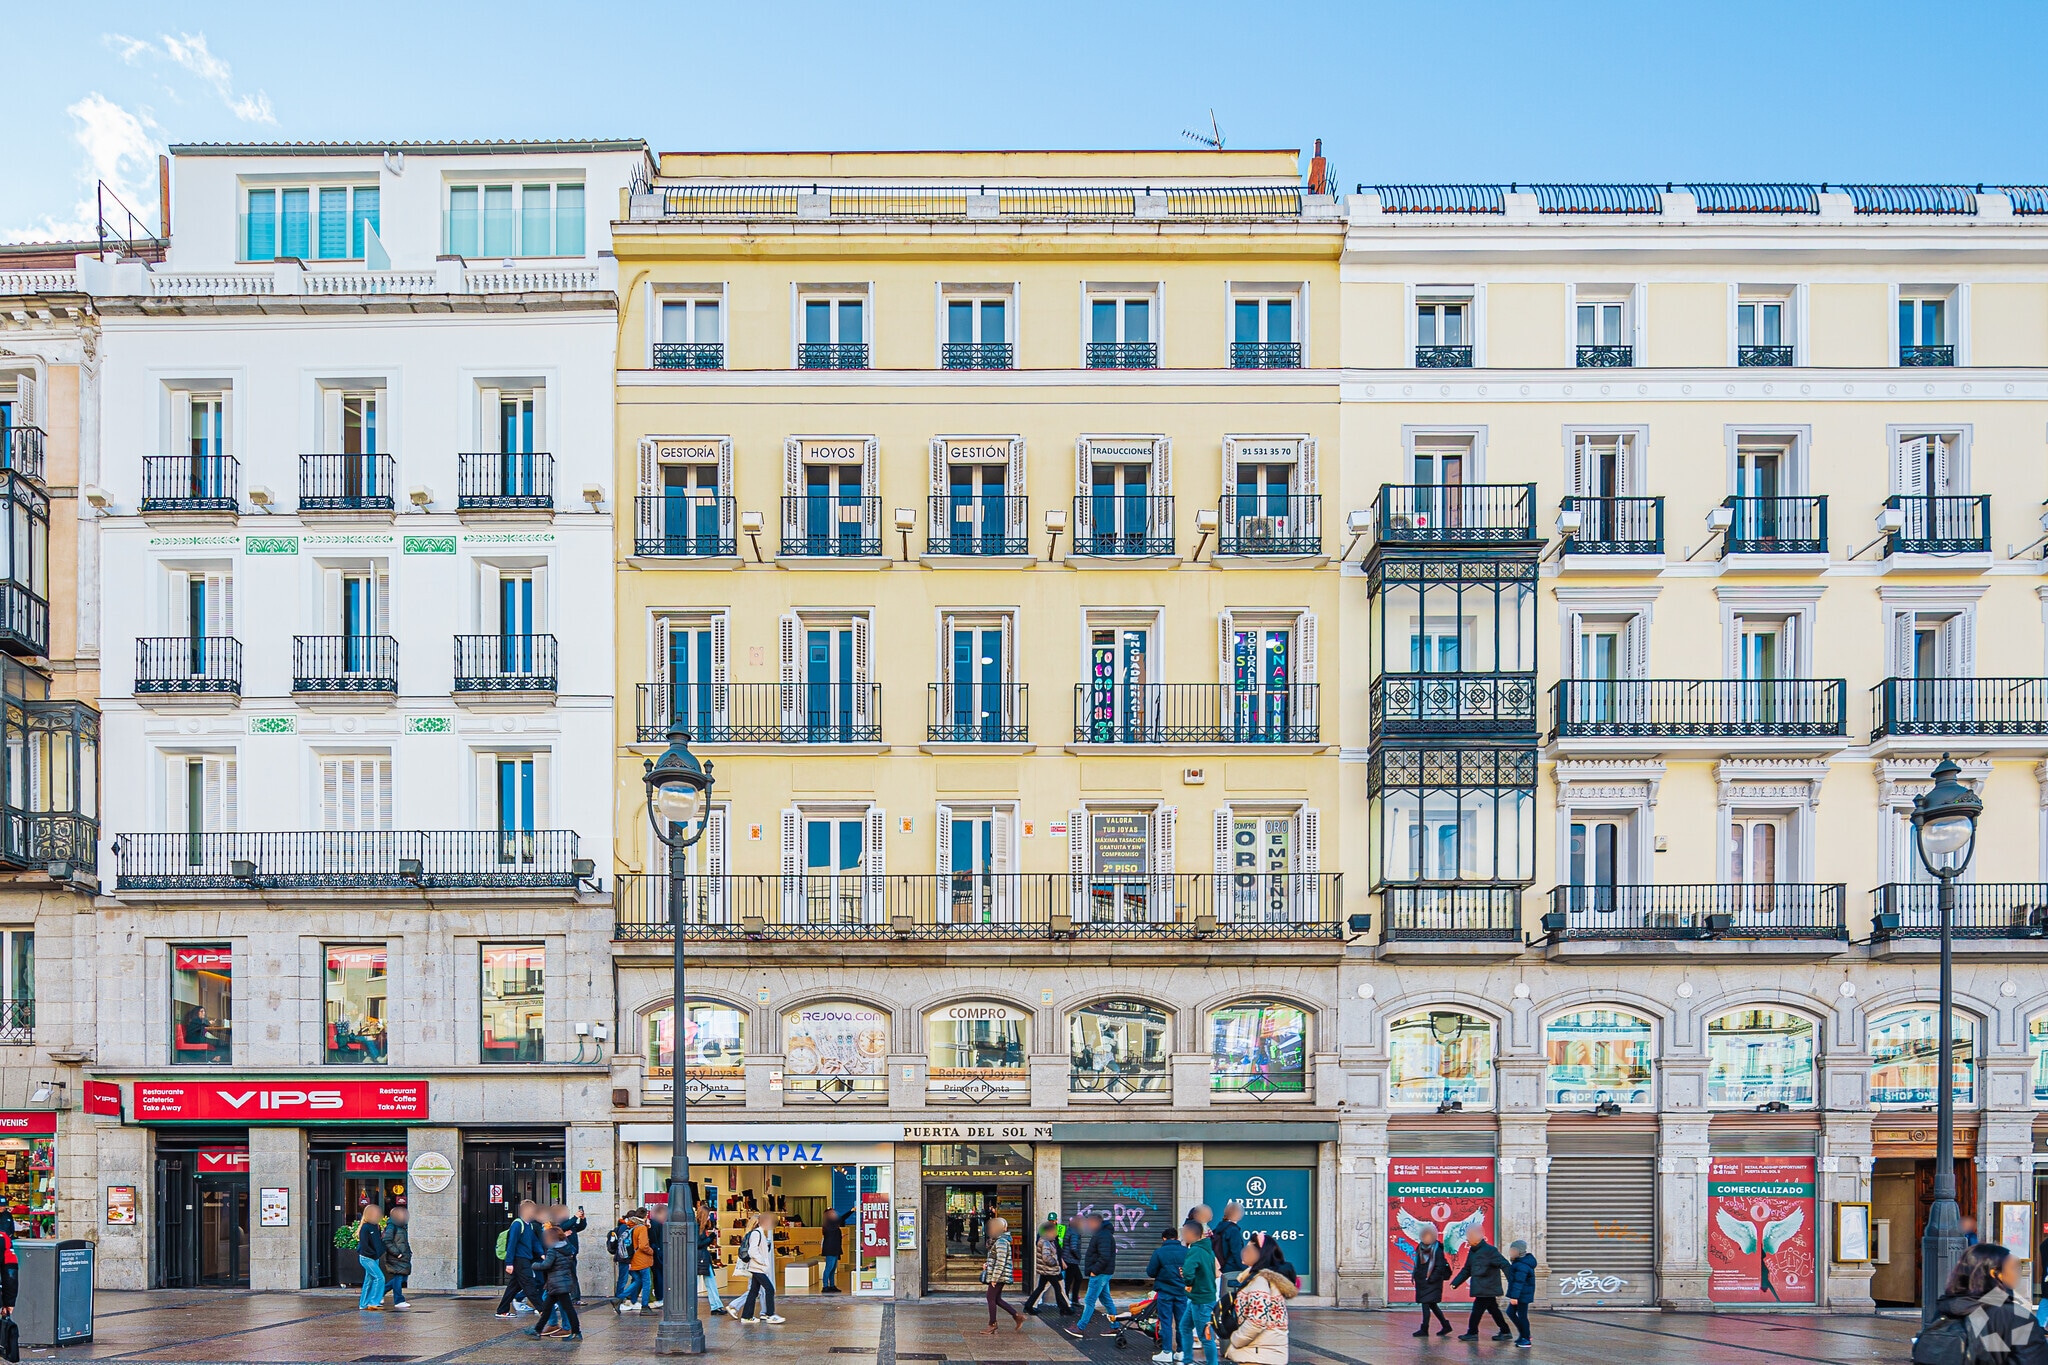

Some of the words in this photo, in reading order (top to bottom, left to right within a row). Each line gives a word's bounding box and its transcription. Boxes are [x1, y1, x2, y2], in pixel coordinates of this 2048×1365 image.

[661, 445, 715, 458] GESTORÍA
[811, 447, 855, 459] HOYOS
[950, 444, 1005, 459] GESTIÓN
[1092, 447, 1152, 456] TRADUCCIONES
[1242, 448, 1251, 456] 91
[1253, 448, 1268, 456] 531
[1270, 448, 1279, 456] 35
[1281, 448, 1291, 456] 70
[1265, 821, 1288, 834] ORO
[1115, 865, 1138, 873] PISO
[180, 954, 232, 963] VIPS
[949, 1008, 1007, 1019] COMPRO
[939, 1068, 978, 1080] Relojes
[663, 1083, 698, 1091] Prera
[944, 1084, 979, 1092] Primera
[981, 1084, 1010, 1092] Planta
[93, 1094, 118, 1103] VIPS
[216, 1091, 343, 1109] VIPS
[1884, 1091, 1913, 1100] SHOP
[904, 1127, 960, 1137] PUERTA
[967, 1127, 995, 1137] DEL
[1002, 1127, 1028, 1137] SOL
[709, 1143, 823, 1162] MARYPAZ
[350, 1152, 380, 1163] Take
[587, 1157, 594, 1168] 3
[582, 1172, 600, 1183] AT
[1989, 1178, 1995, 1187] 5
[1398, 1186, 1484, 1194] COMERCIALIZADO
[1717, 1185, 1804, 1194] COMERCIALIZADO
[863, 1203, 889, 1211] REMATE
